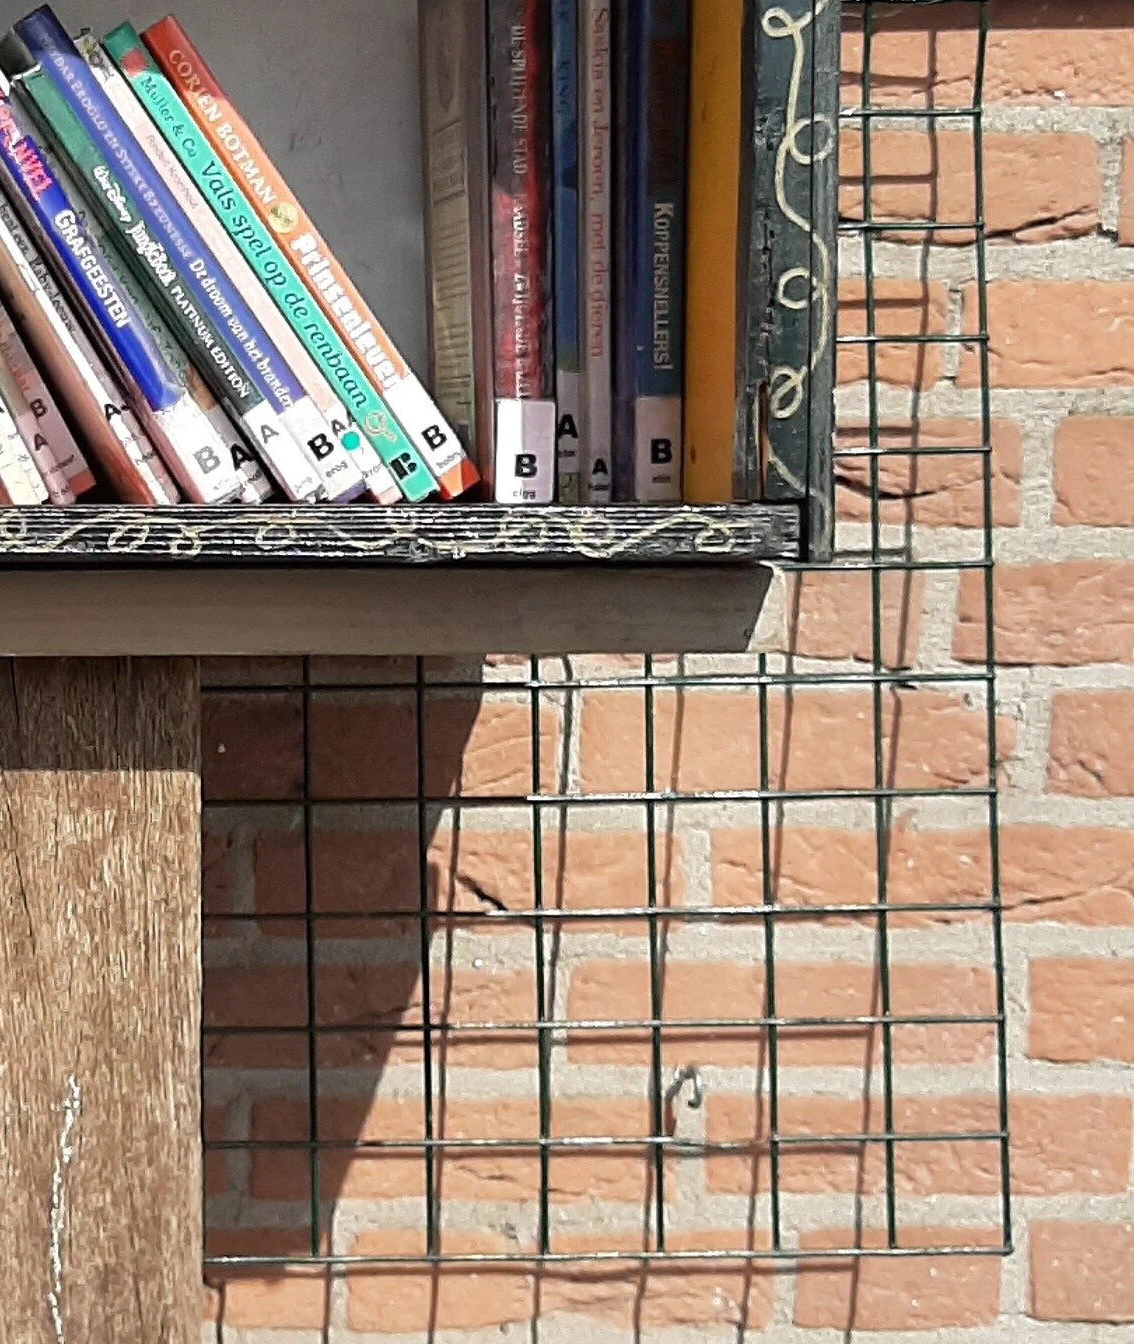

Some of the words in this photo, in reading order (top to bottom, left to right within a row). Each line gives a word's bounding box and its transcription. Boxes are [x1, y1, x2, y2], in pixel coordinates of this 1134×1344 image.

[592, 7, 609, 80] Saskia
[138, 73, 178, 124] Muller
[169, 120, 187, 138] &
[591, 89, 602, 113] en
[164, 45, 225, 124] CORIEN
[212, 119, 279, 207] BOTMAN
[187, 255, 211, 279] De
[591, 260, 607, 284] de
[196, 159, 241, 213] Vals
[224, 208, 271, 262] spel
[256, 256, 290, 292] op
[281, 285, 313, 320] de
[300, 316, 372, 410] renbaan
[198, 272, 237, 319] droom
[652, 202, 674, 370] KOPPENSNELLERS!
[224, 313, 250, 343] van
[589, 289, 607, 357] dieren
[167, 283, 217, 349] PLATINUM
[208, 342, 252, 399] EDITION
[240, 335, 268, 364] het
[260, 424, 279, 443] A
[421, 425, 447, 451] B
[558, 414, 579, 438] A
[192, 445, 221, 474] B
[230, 443, 256, 470] A
[307, 433, 334, 461] B
[651, 439, 673, 464] B
[515, 454, 537, 478] B
[592, 458, 608, 474] A
